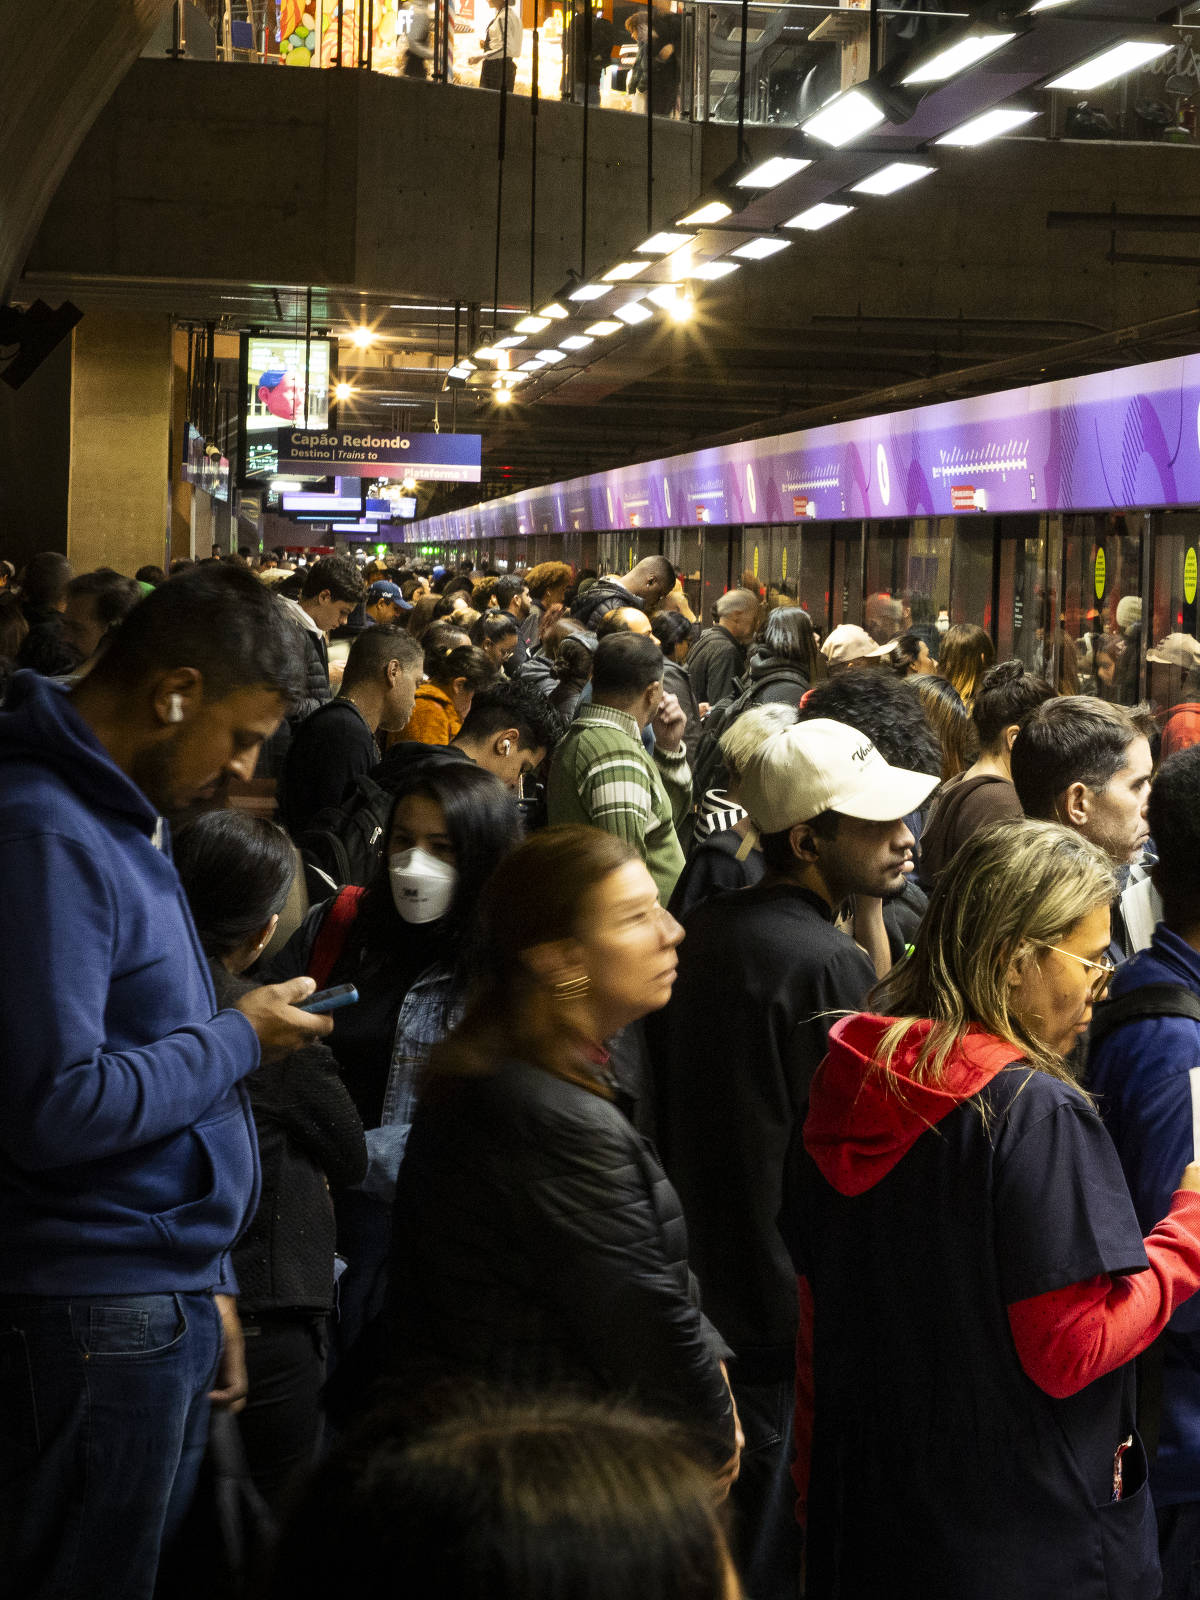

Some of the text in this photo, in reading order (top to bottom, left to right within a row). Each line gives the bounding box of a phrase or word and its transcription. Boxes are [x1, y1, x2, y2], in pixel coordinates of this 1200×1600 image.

[290, 433, 410, 449] Capão Redondo
[290, 449, 378, 460] Destino Trains to
[404, 468, 459, 479] Plataforma
